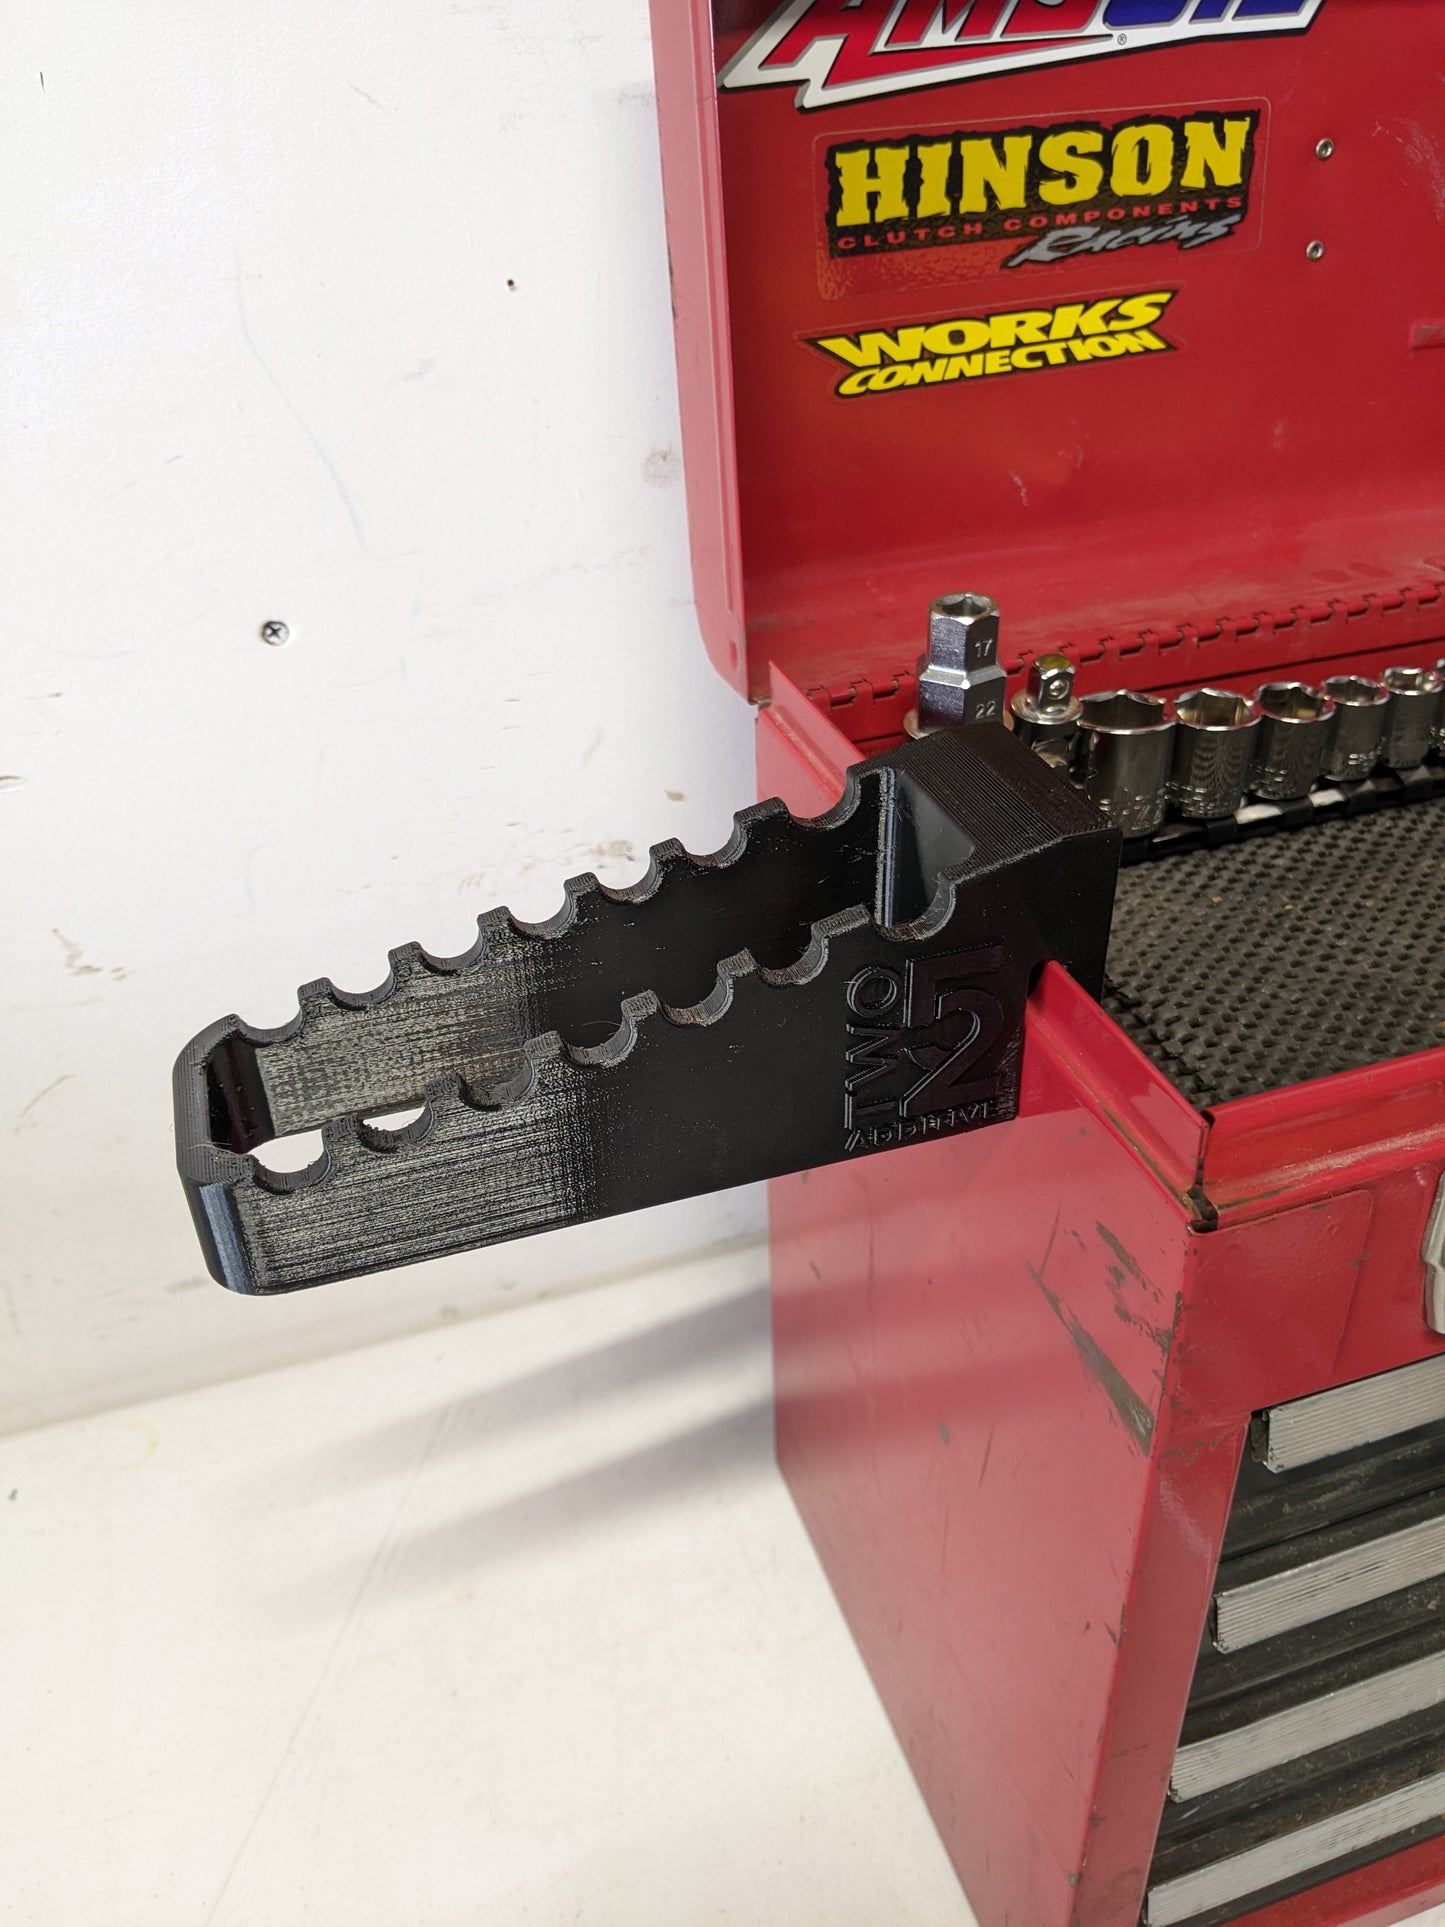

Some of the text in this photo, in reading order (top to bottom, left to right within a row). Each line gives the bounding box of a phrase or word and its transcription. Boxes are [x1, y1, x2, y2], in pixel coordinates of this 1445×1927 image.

[835, 117, 1250, 227] HINSON
[837, 196, 1243, 250] CLUTCH COMPONENTS
[816, 290, 1174, 368] WORKS
[838, 328, 1168, 396] CONNECTION
[975, 639, 993, 658] 17
[975, 701, 996, 720] 22
